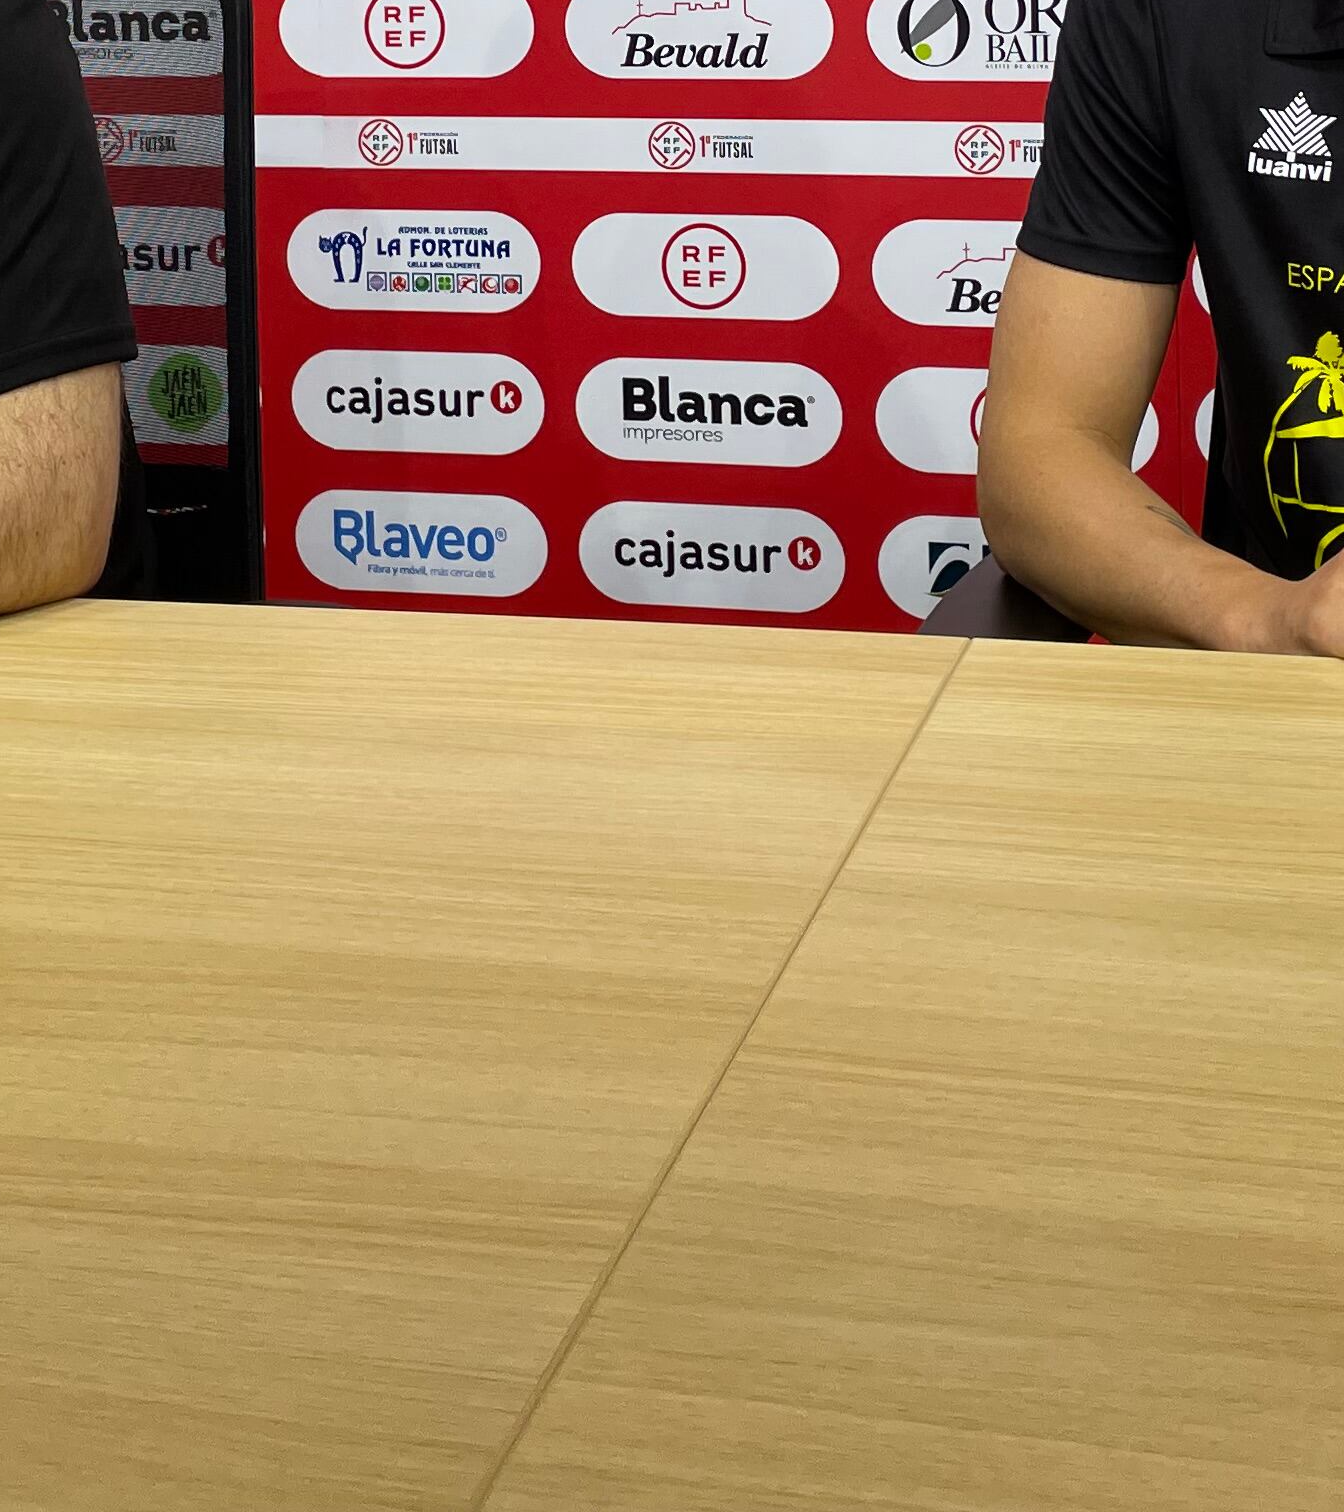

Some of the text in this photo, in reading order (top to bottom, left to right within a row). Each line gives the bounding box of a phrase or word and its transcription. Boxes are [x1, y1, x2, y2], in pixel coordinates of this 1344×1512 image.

[621, 33, 768, 68] Bevald
[1248, 152, 1332, 181] luanvi
[377, 238, 510, 259] LA FORTUNA
[622, 376, 808, 427] Blanca
[623, 428, 723, 443] impresores
[334, 509, 494, 565] Blaveo
